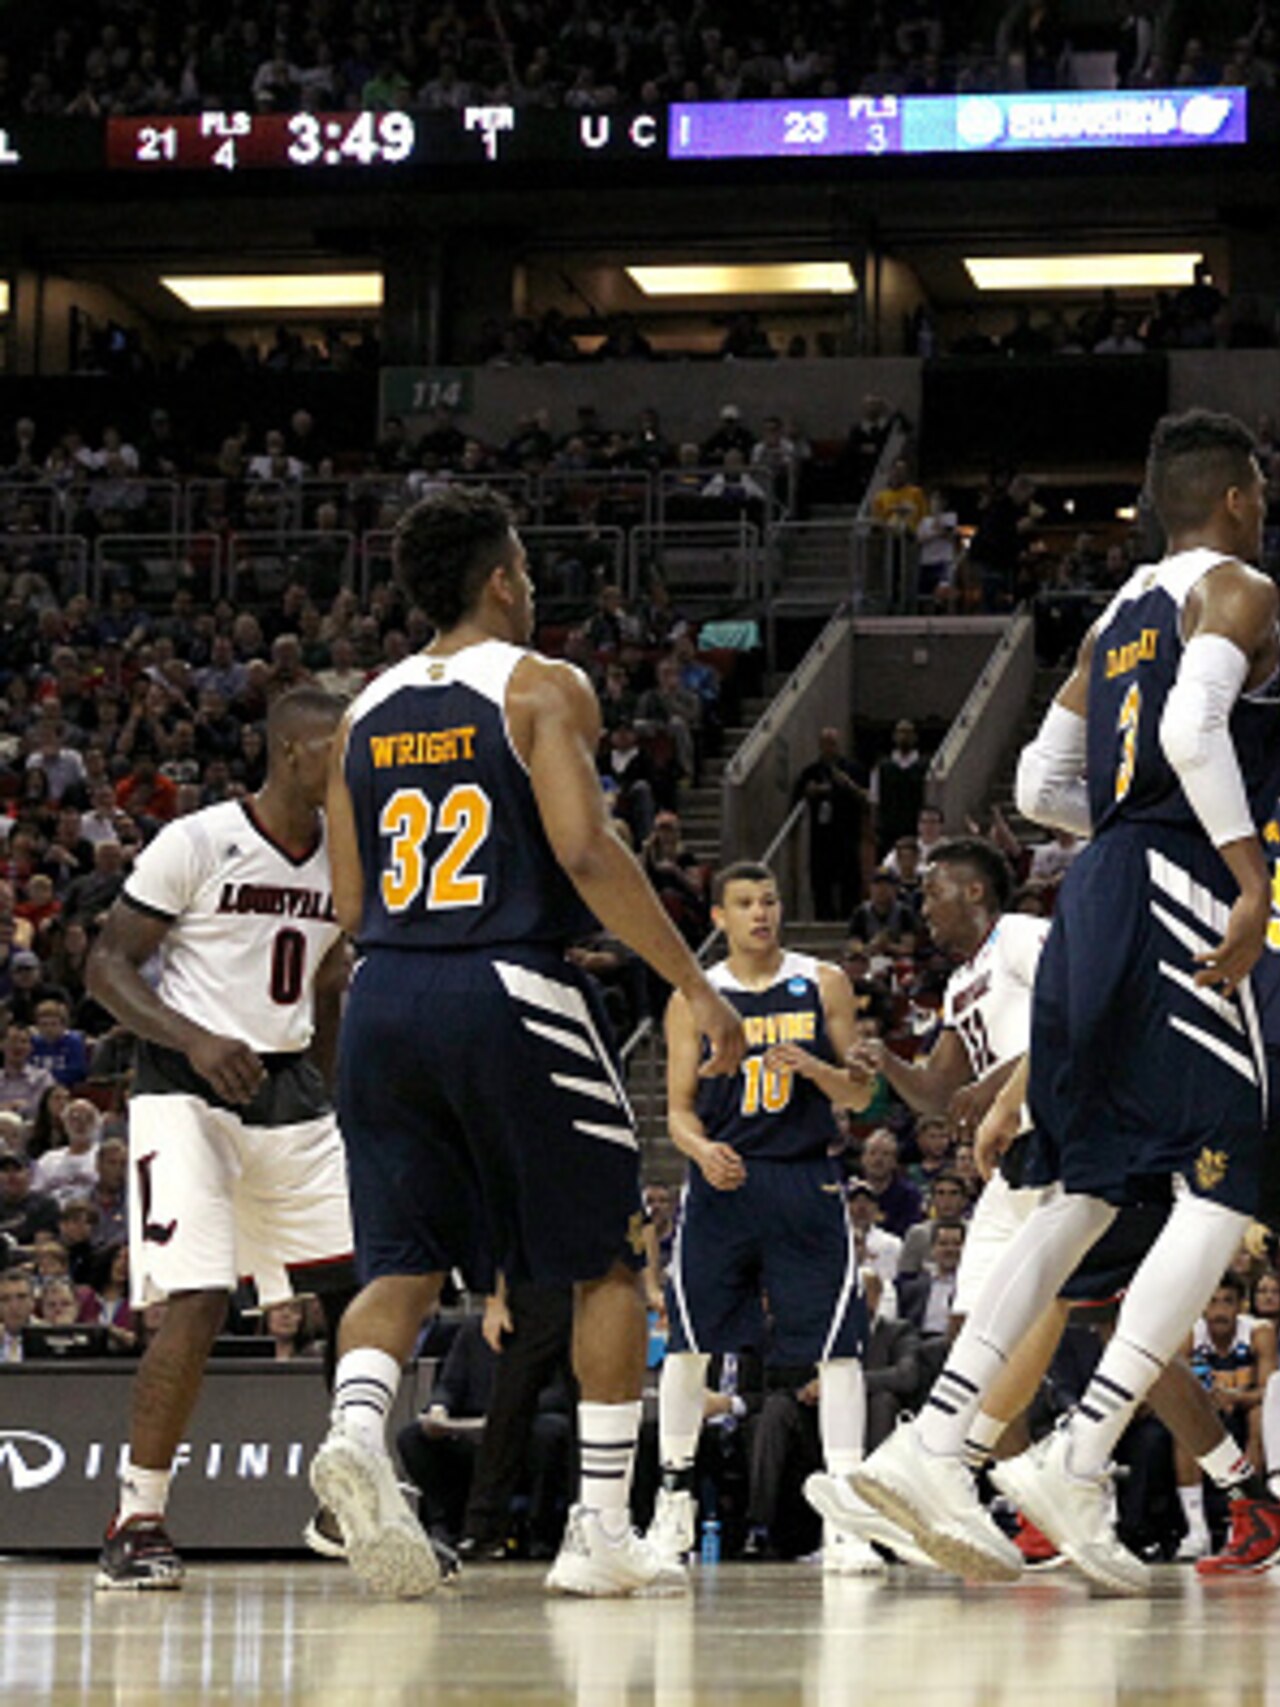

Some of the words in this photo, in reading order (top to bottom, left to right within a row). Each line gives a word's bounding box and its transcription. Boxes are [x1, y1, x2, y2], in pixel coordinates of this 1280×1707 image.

[136, 127, 177, 160] 21
[288, 112, 415, 164] 3:49
[784, 111, 828, 143] 23
[866, 123, 887, 154] 3
[213, 138, 235, 170] 4
[483, 131, 497, 159] 1
[412, 382, 461, 407] 114
[369, 726, 477, 769] WRIGHT
[379, 784, 492, 914] 32
[269, 927, 307, 1005] 0
[741, 1056, 794, 1115] 10
